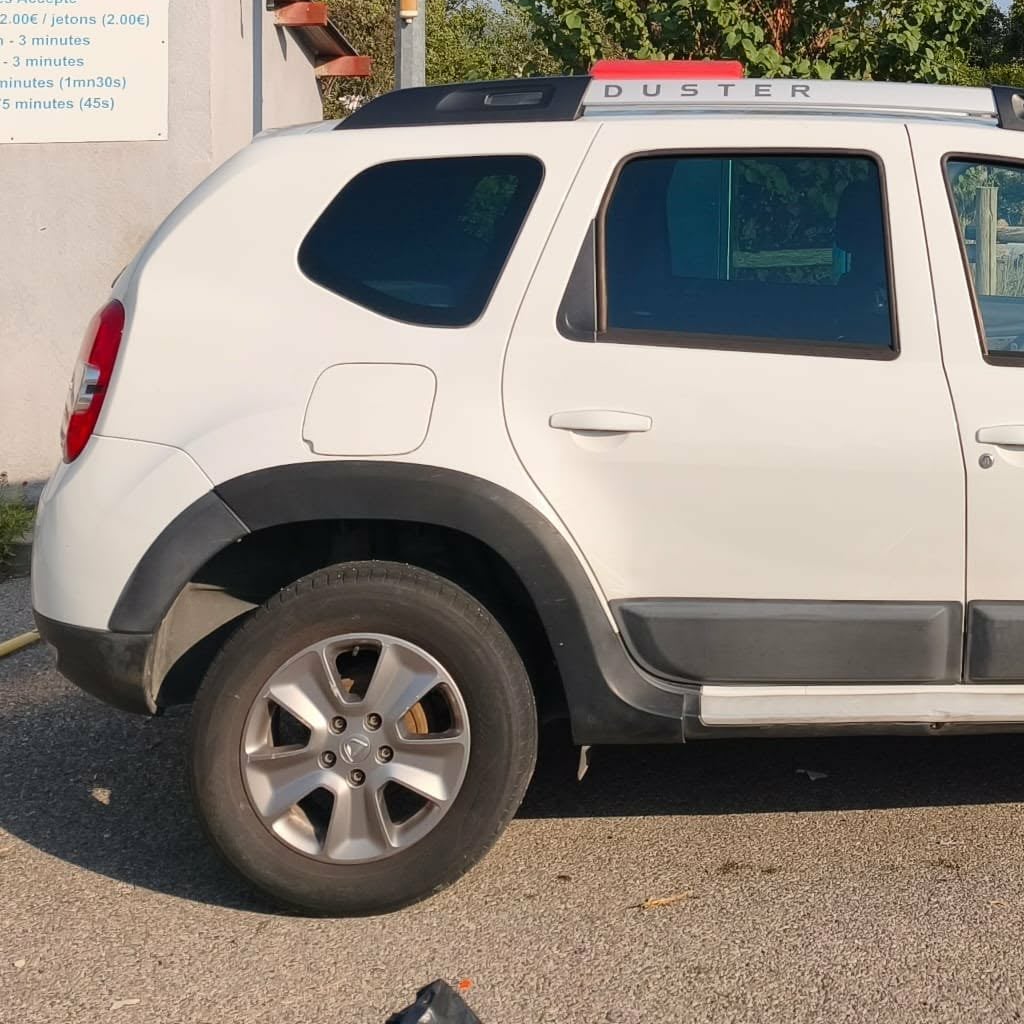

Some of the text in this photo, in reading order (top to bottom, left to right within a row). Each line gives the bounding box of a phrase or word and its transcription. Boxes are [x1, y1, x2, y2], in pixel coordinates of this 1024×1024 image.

[0, 13, 38, 25] 2.00€
[50, 13, 97, 27] jetons
[101, 13, 150, 27] (2.00€)
[18, 34, 26, 46] 3
[31, 34, 90, 46] minutes
[12, 56, 20, 67] 3
[25, 55, 85, 67] minutes
[59, 76, 127, 90] (1mn30s)
[604, 84, 811, 98] DUSTER
[0, 97, 114, 111] 5 minutes (45s)
